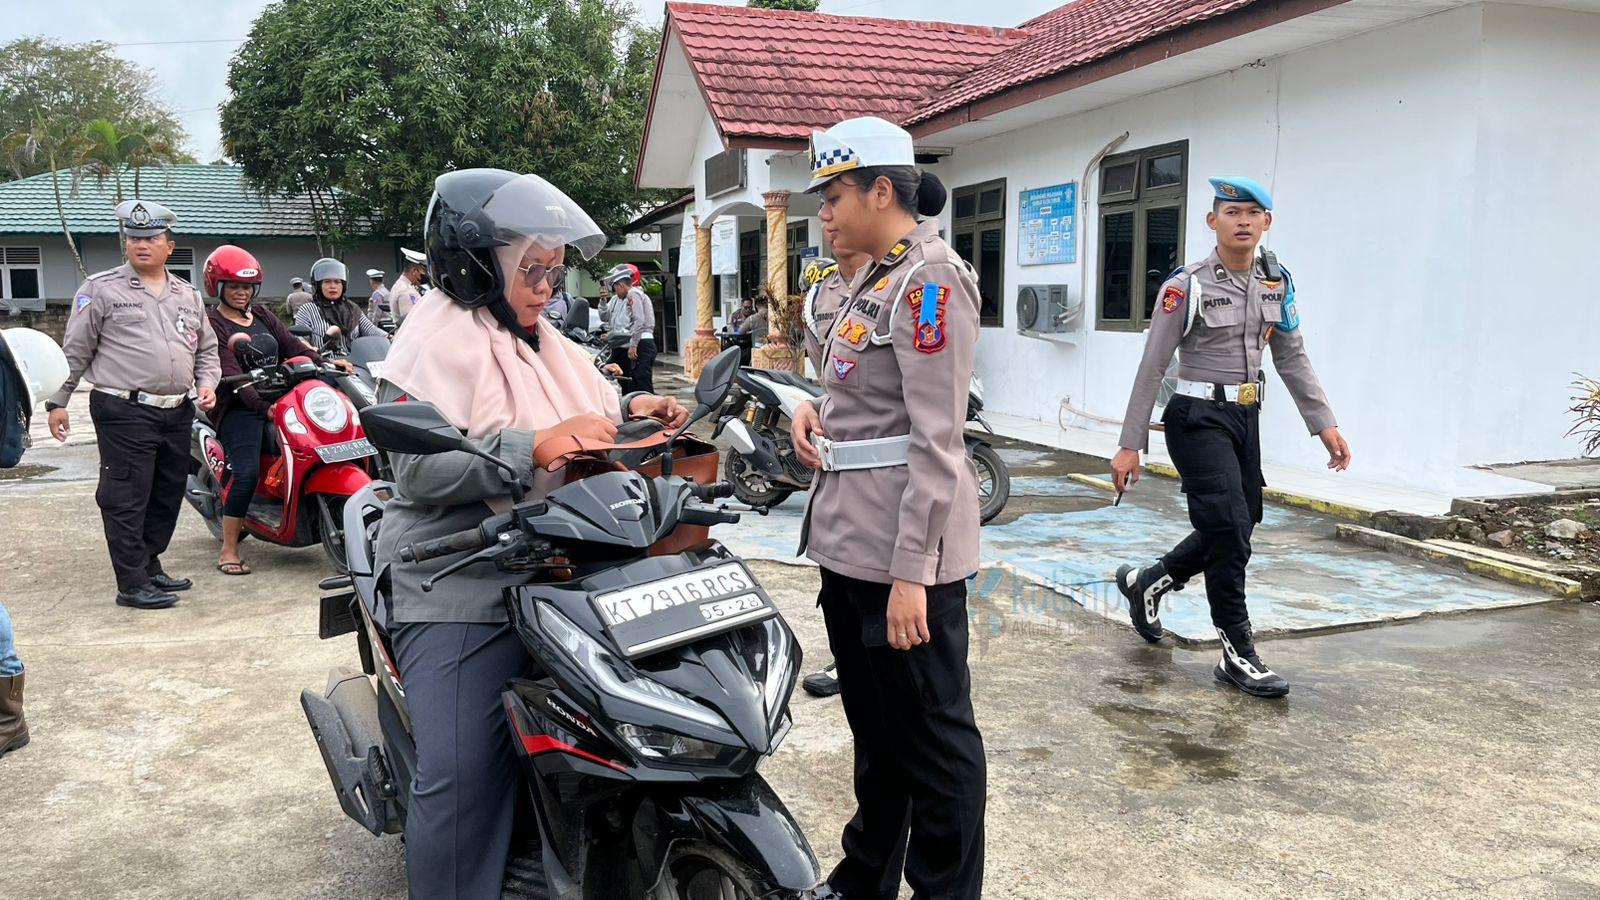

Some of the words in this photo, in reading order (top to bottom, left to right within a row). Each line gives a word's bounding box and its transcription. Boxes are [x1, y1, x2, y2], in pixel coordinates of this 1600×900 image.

[1203, 296, 1232, 309] PUTRA
[609, 498, 646, 511] HONDA
[605, 598, 638, 624] KT
[643, 582, 703, 614] 2916
[703, 571, 747, 602] RCS
[545, 696, 598, 738] HONDA
